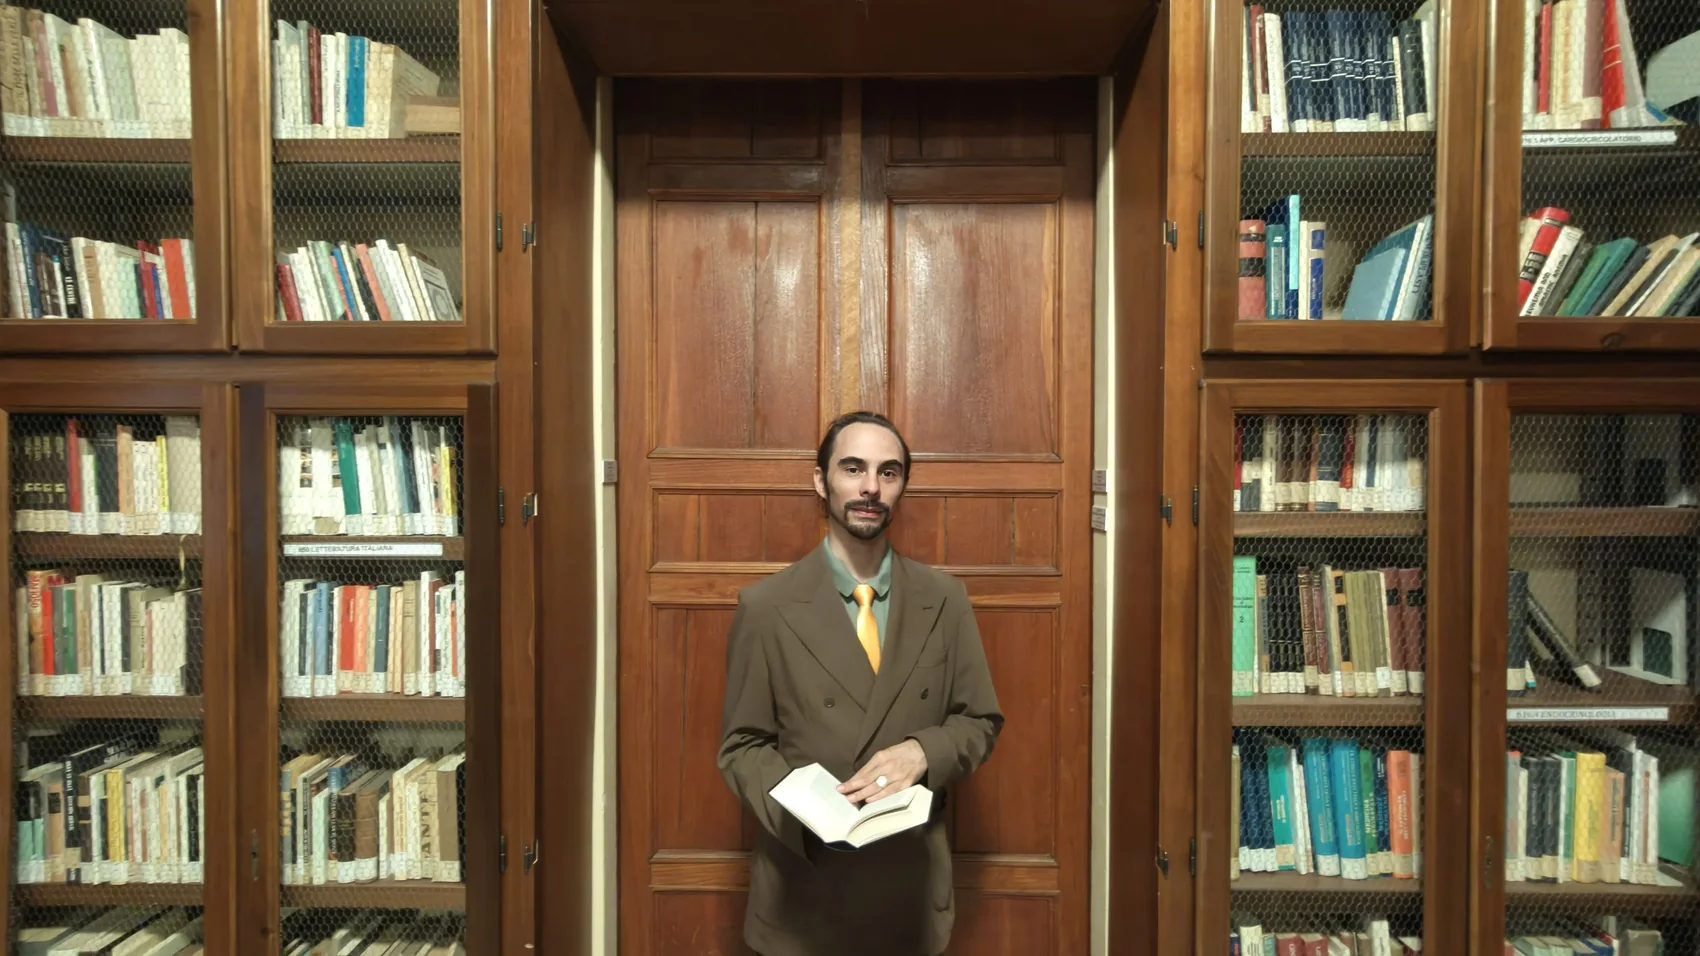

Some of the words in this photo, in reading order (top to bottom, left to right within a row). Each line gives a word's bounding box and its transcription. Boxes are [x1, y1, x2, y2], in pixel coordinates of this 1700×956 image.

[1525, 283, 1544, 316] EUKEMIA
[311, 545, 360, 553] LETTERATURA
[361, 544, 393, 552] ITALIANA
[1239, 615, 1245, 624] 2
